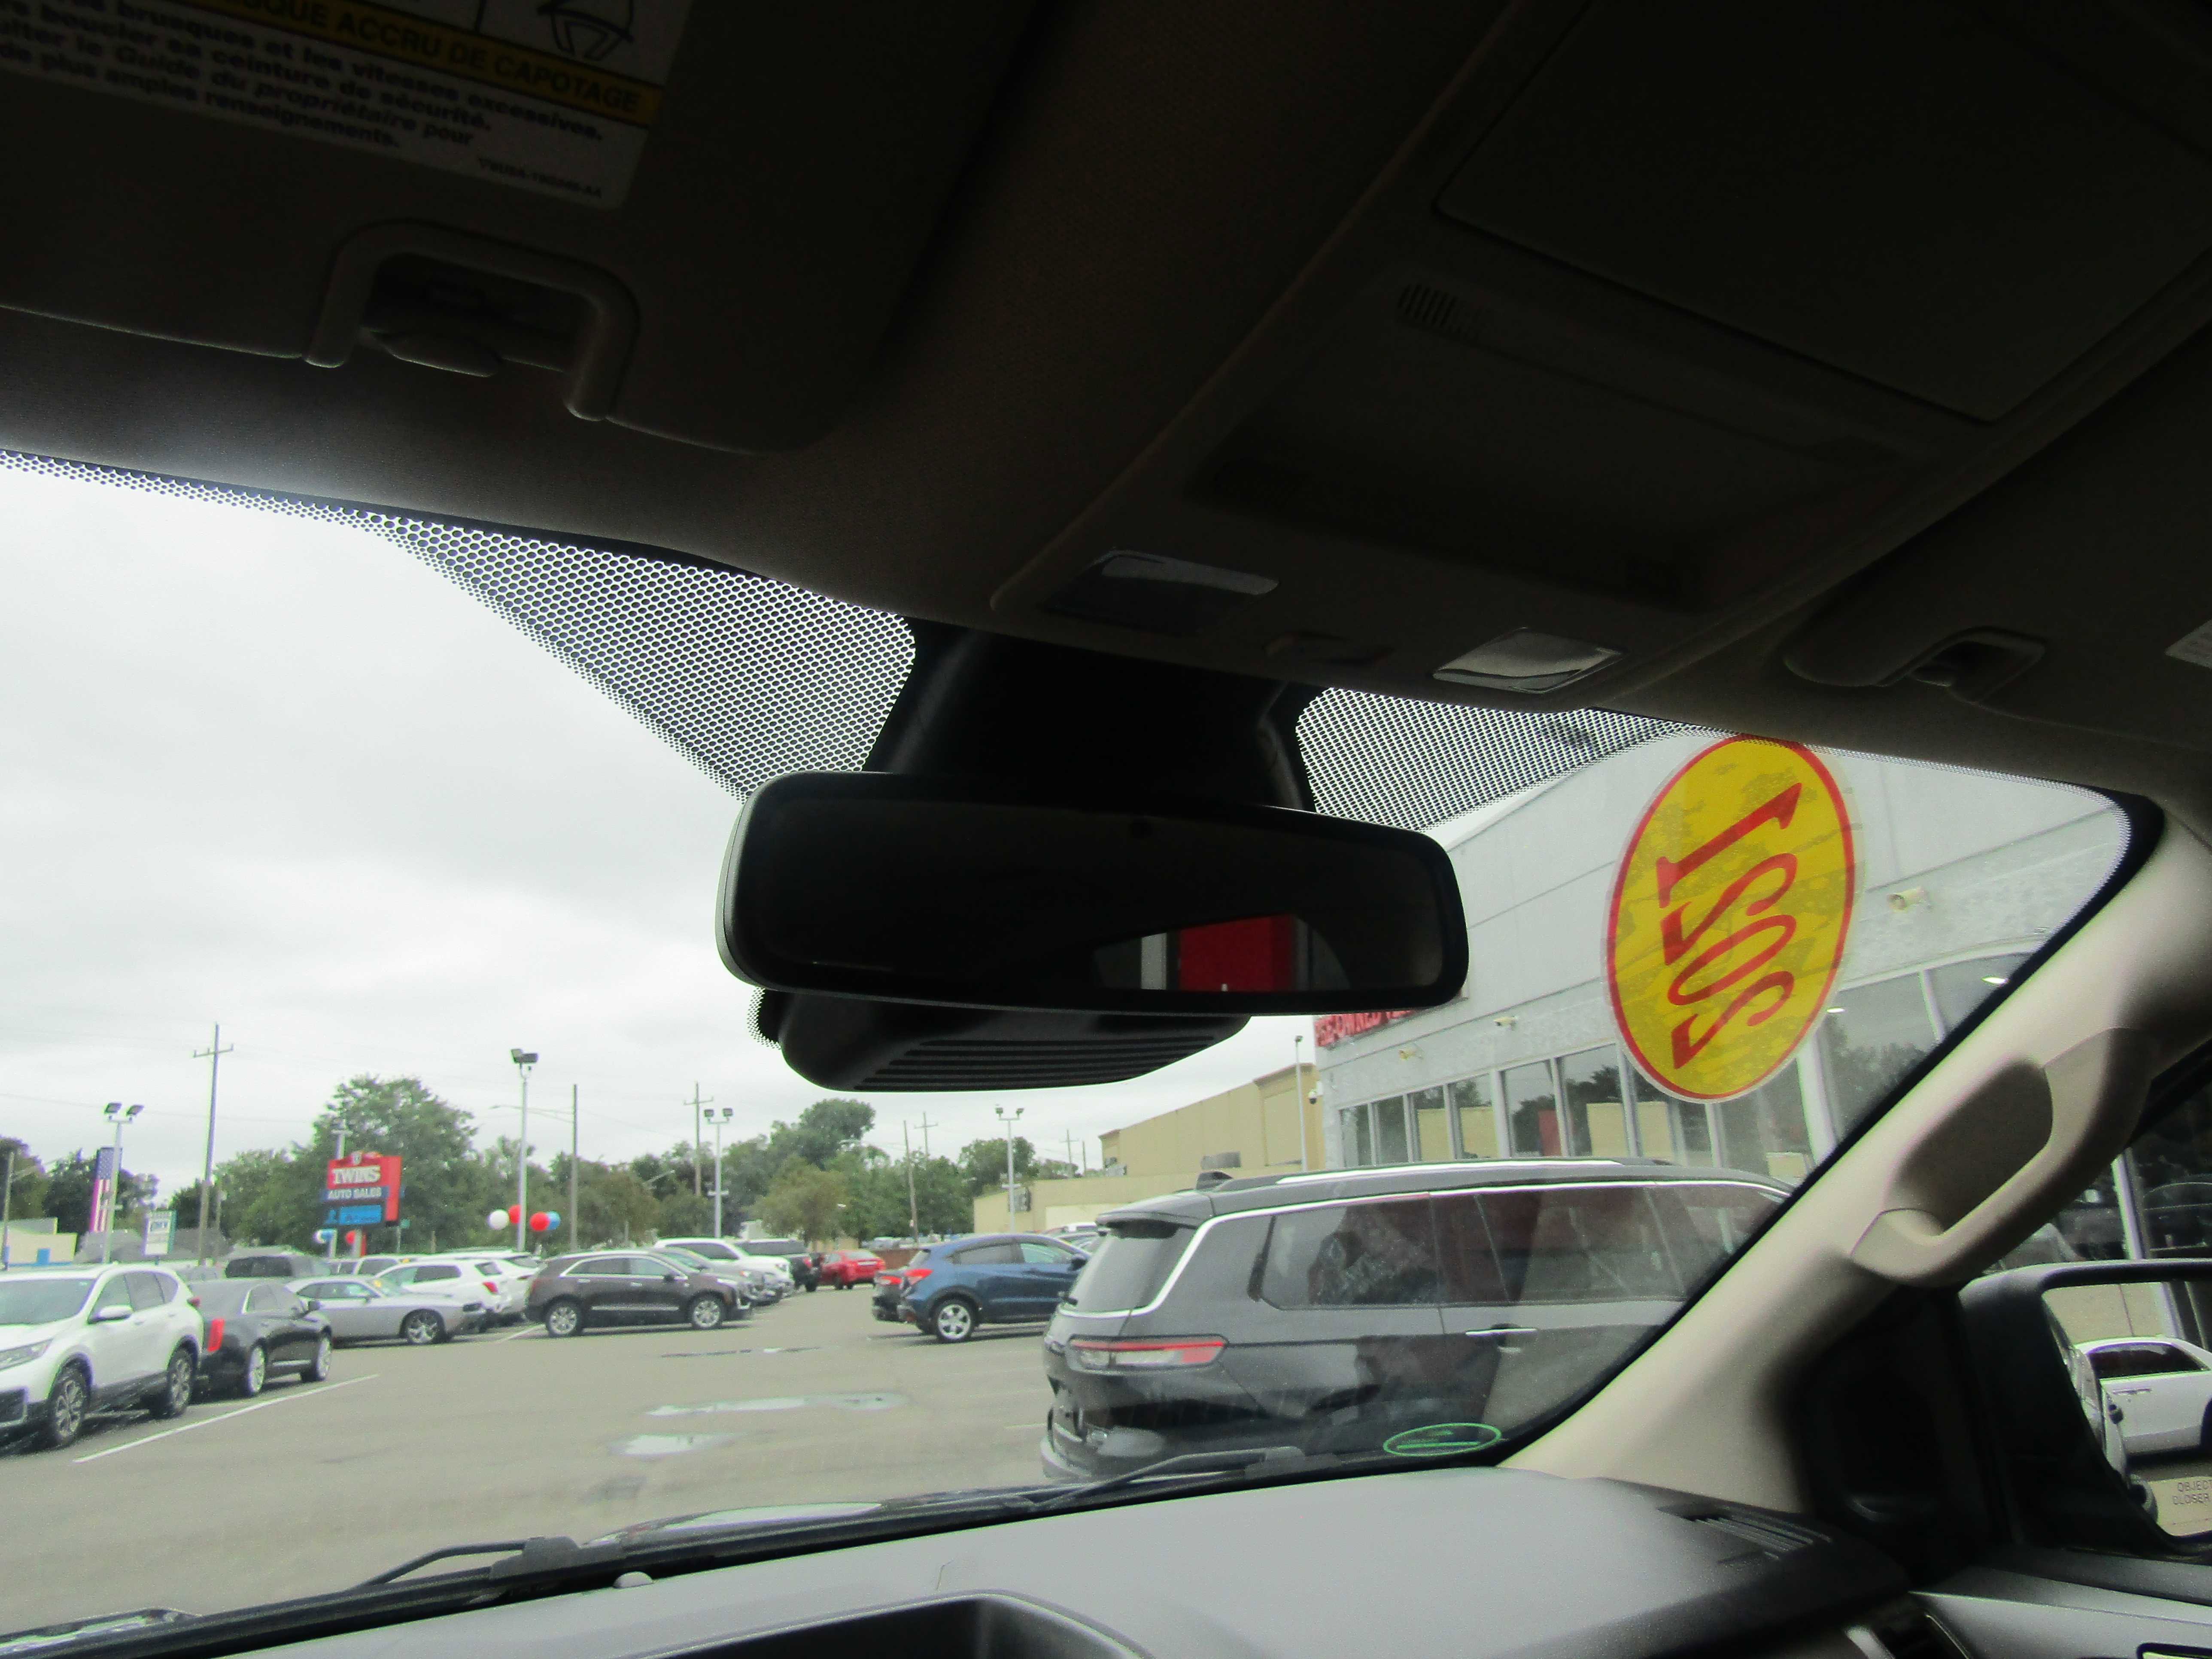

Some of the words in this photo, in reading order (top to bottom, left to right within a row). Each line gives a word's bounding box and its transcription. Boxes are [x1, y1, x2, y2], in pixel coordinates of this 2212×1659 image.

[264, 41, 294, 60] et
[336, 12, 442, 58] ACCRU
[447, 41, 487, 71] DE
[494, 55, 639, 113] CAPOTAGE
[115, 45, 200, 79] Guide
[210, 71, 246, 91] du
[422, 123, 474, 145] pour
[332, 1164, 381, 1185] TWINS
[327, 1189, 352, 1200] AUTO
